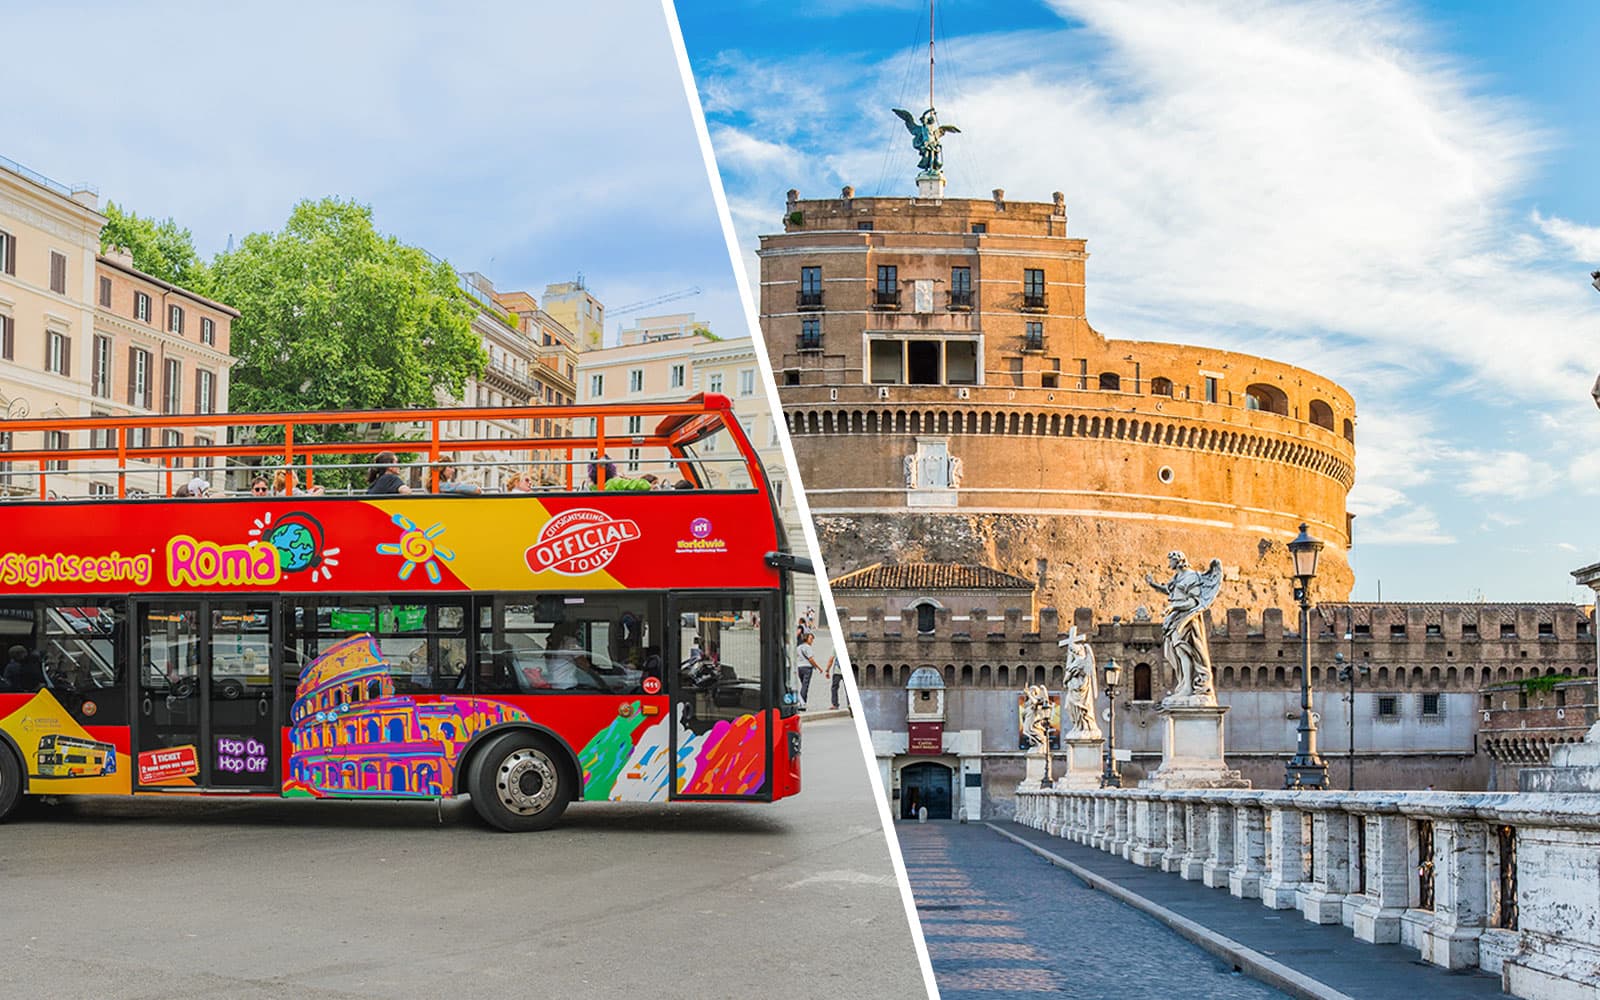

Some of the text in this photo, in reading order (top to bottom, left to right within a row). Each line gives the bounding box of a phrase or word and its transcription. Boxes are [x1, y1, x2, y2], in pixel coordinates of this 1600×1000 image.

[546, 511, 604, 537] CITYSIGHTSEEING
[536, 523, 634, 566] OFFICIAL
[569, 548, 613, 571] TOUR
[157, 752, 182, 762] TICKET
[218, 737, 265, 756] Hop On
[218, 755, 268, 773] Hop Off
